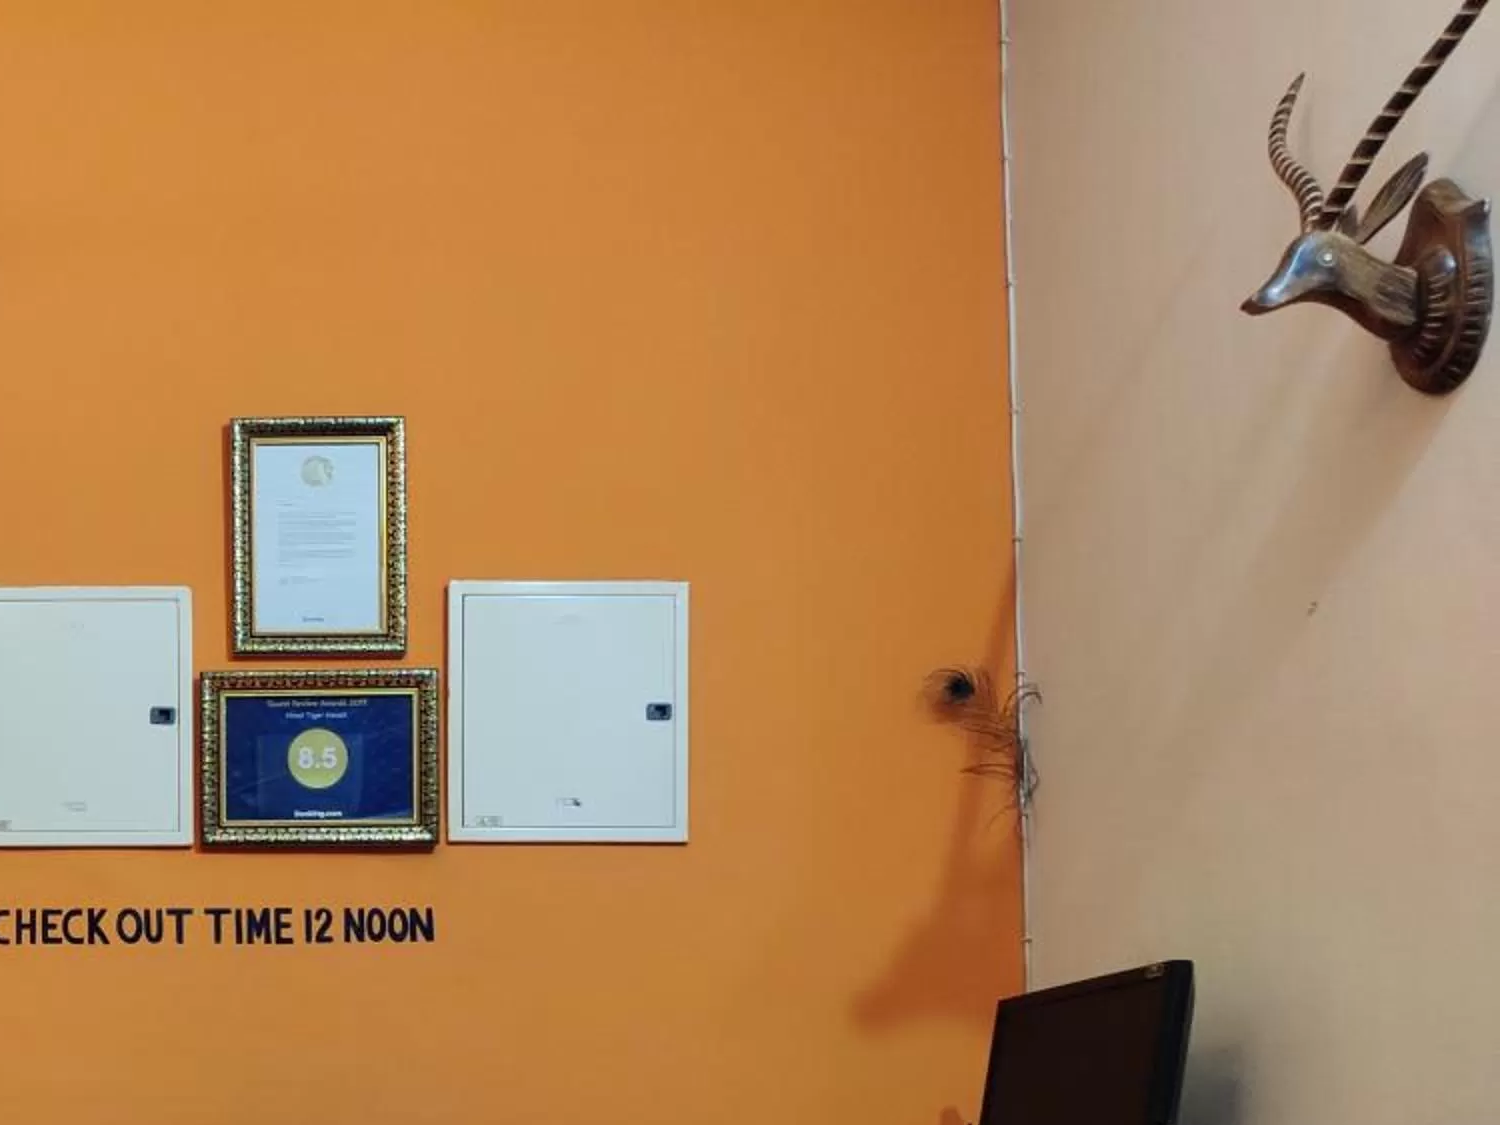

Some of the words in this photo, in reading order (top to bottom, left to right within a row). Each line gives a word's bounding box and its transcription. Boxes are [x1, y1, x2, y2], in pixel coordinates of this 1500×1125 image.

[298, 746, 338, 770] 8.5
[203, 907, 294, 944] TIME
[304, 907, 333, 943] 12
[343, 907, 435, 943] NOON
